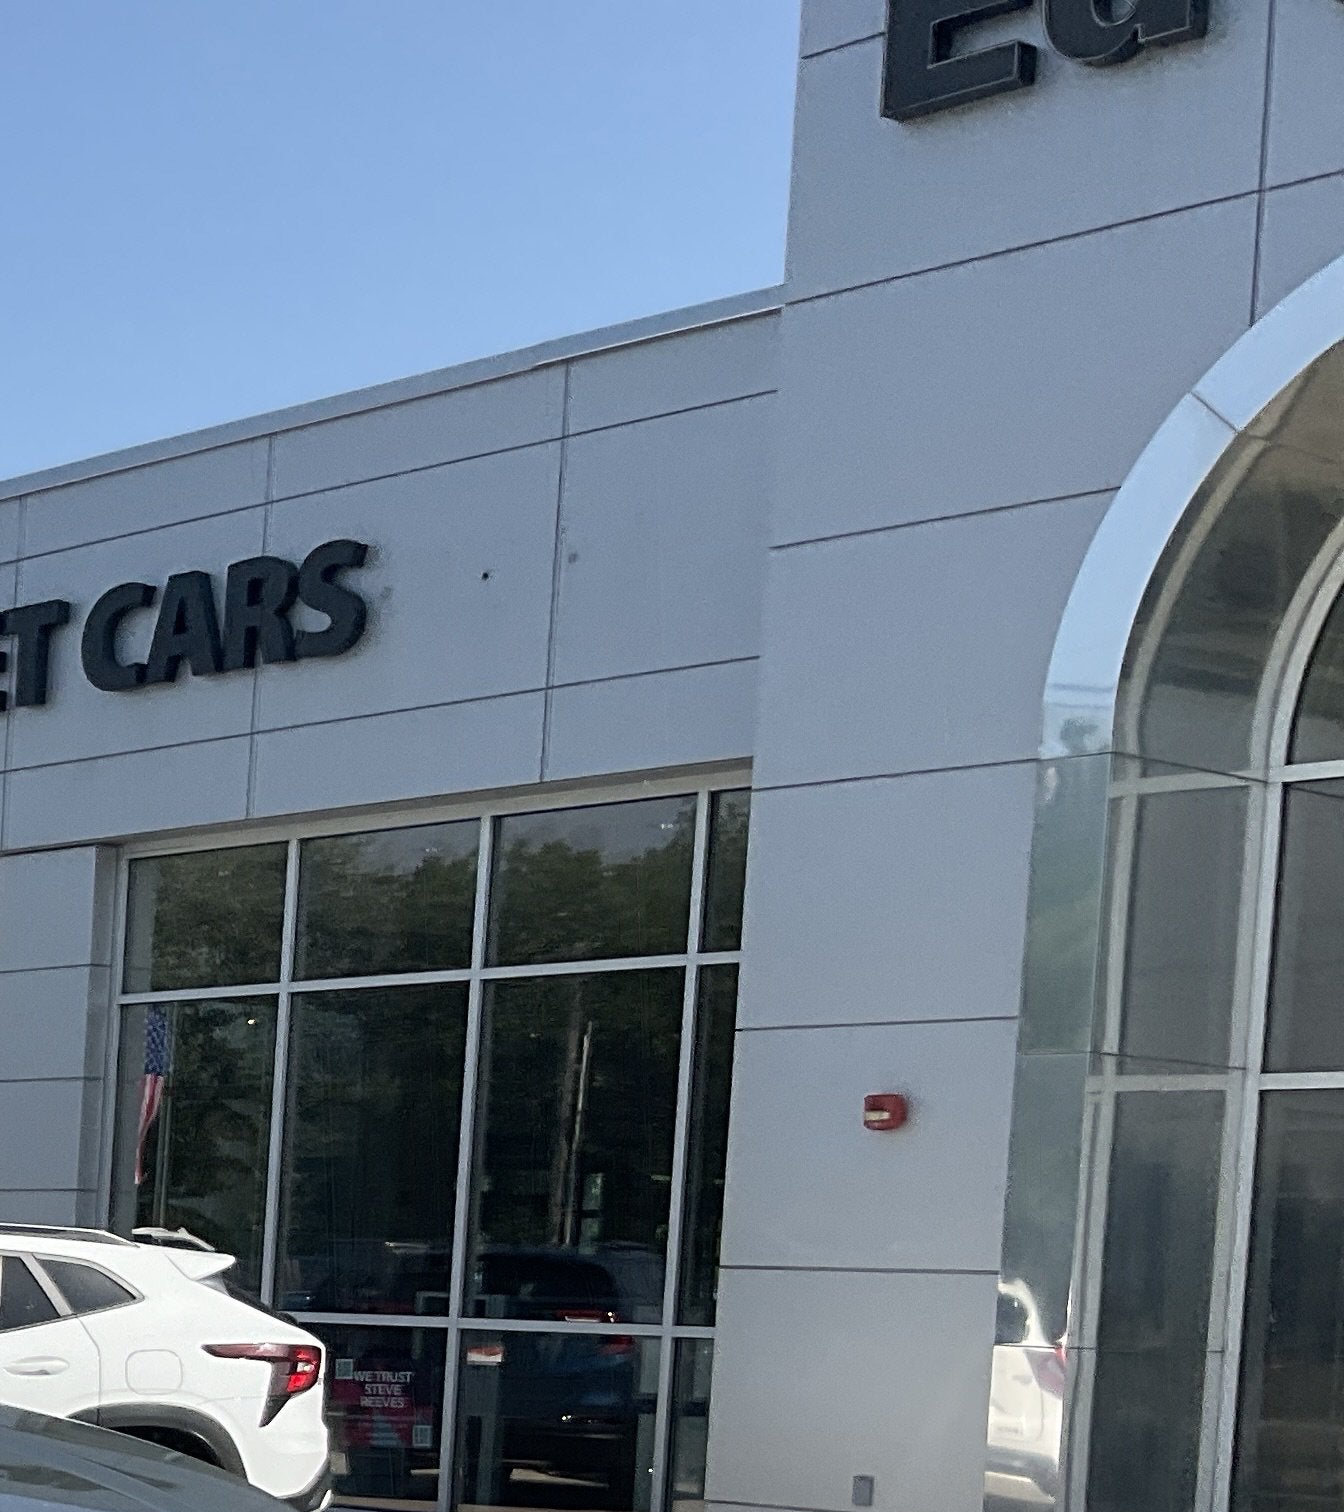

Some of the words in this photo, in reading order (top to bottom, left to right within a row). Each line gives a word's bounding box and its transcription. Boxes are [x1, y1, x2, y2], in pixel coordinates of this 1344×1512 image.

[81, 539, 369, 692] CARS
[376, 1371, 412, 1383] TRUST
[365, 1384, 402, 1395] STEVE
[360, 1396, 404, 1408] REEVES
